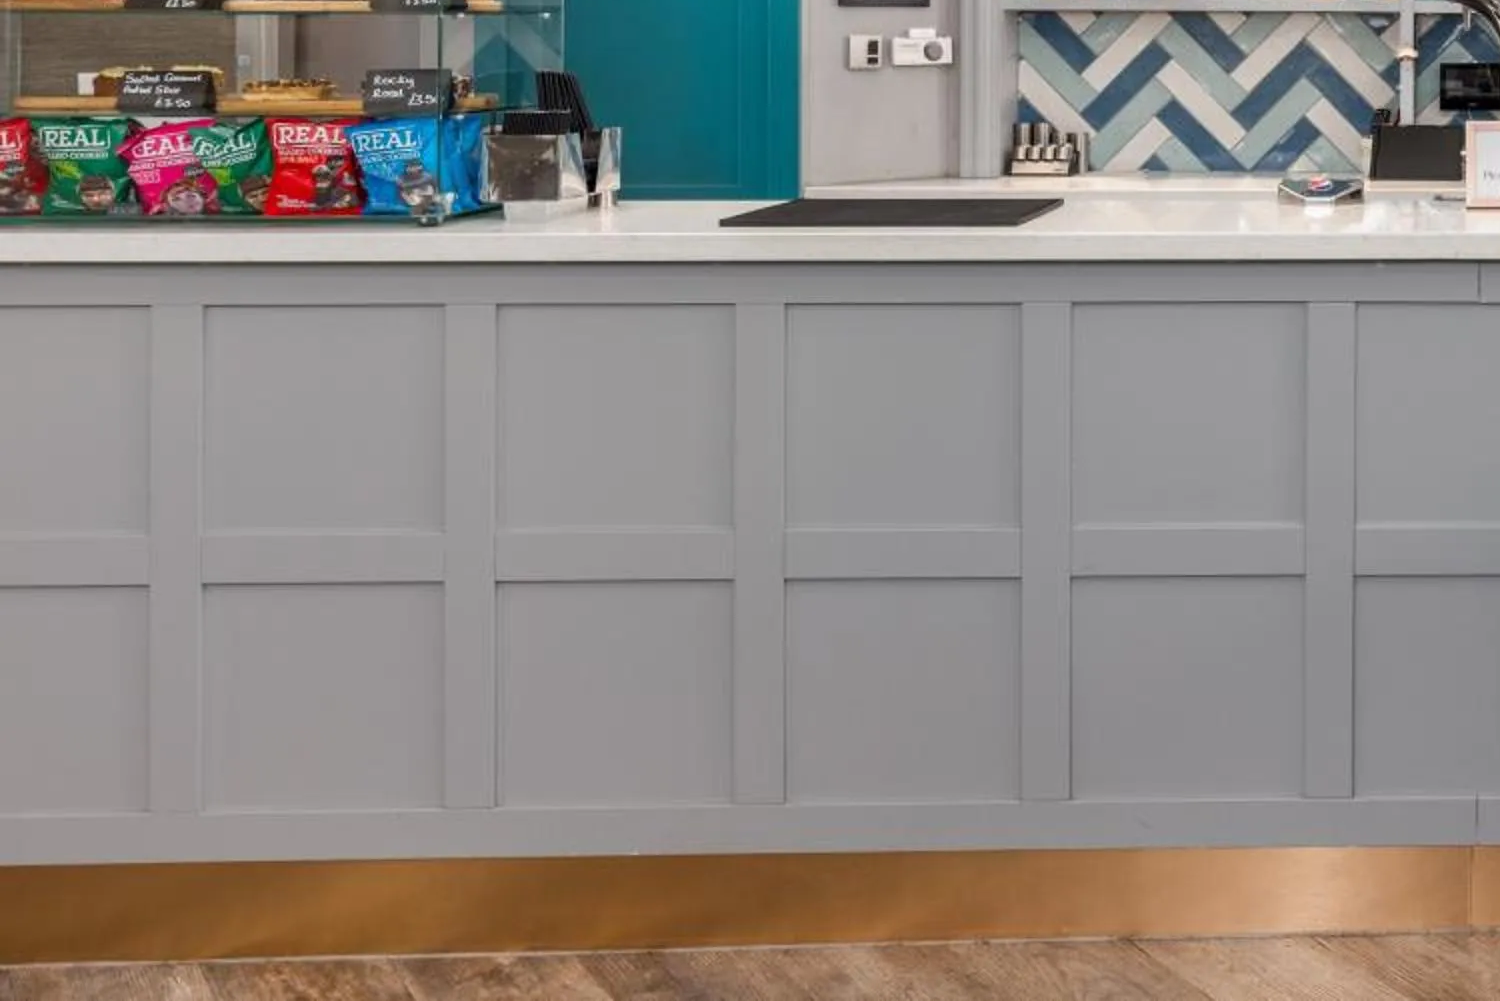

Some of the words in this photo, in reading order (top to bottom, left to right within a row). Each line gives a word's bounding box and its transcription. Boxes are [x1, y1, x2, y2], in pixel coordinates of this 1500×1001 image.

[373, 75, 415, 89] Rocky
[45, 129, 105, 148] REAL
[279, 126, 346, 144] REAL
[356, 130, 417, 152] REAL
